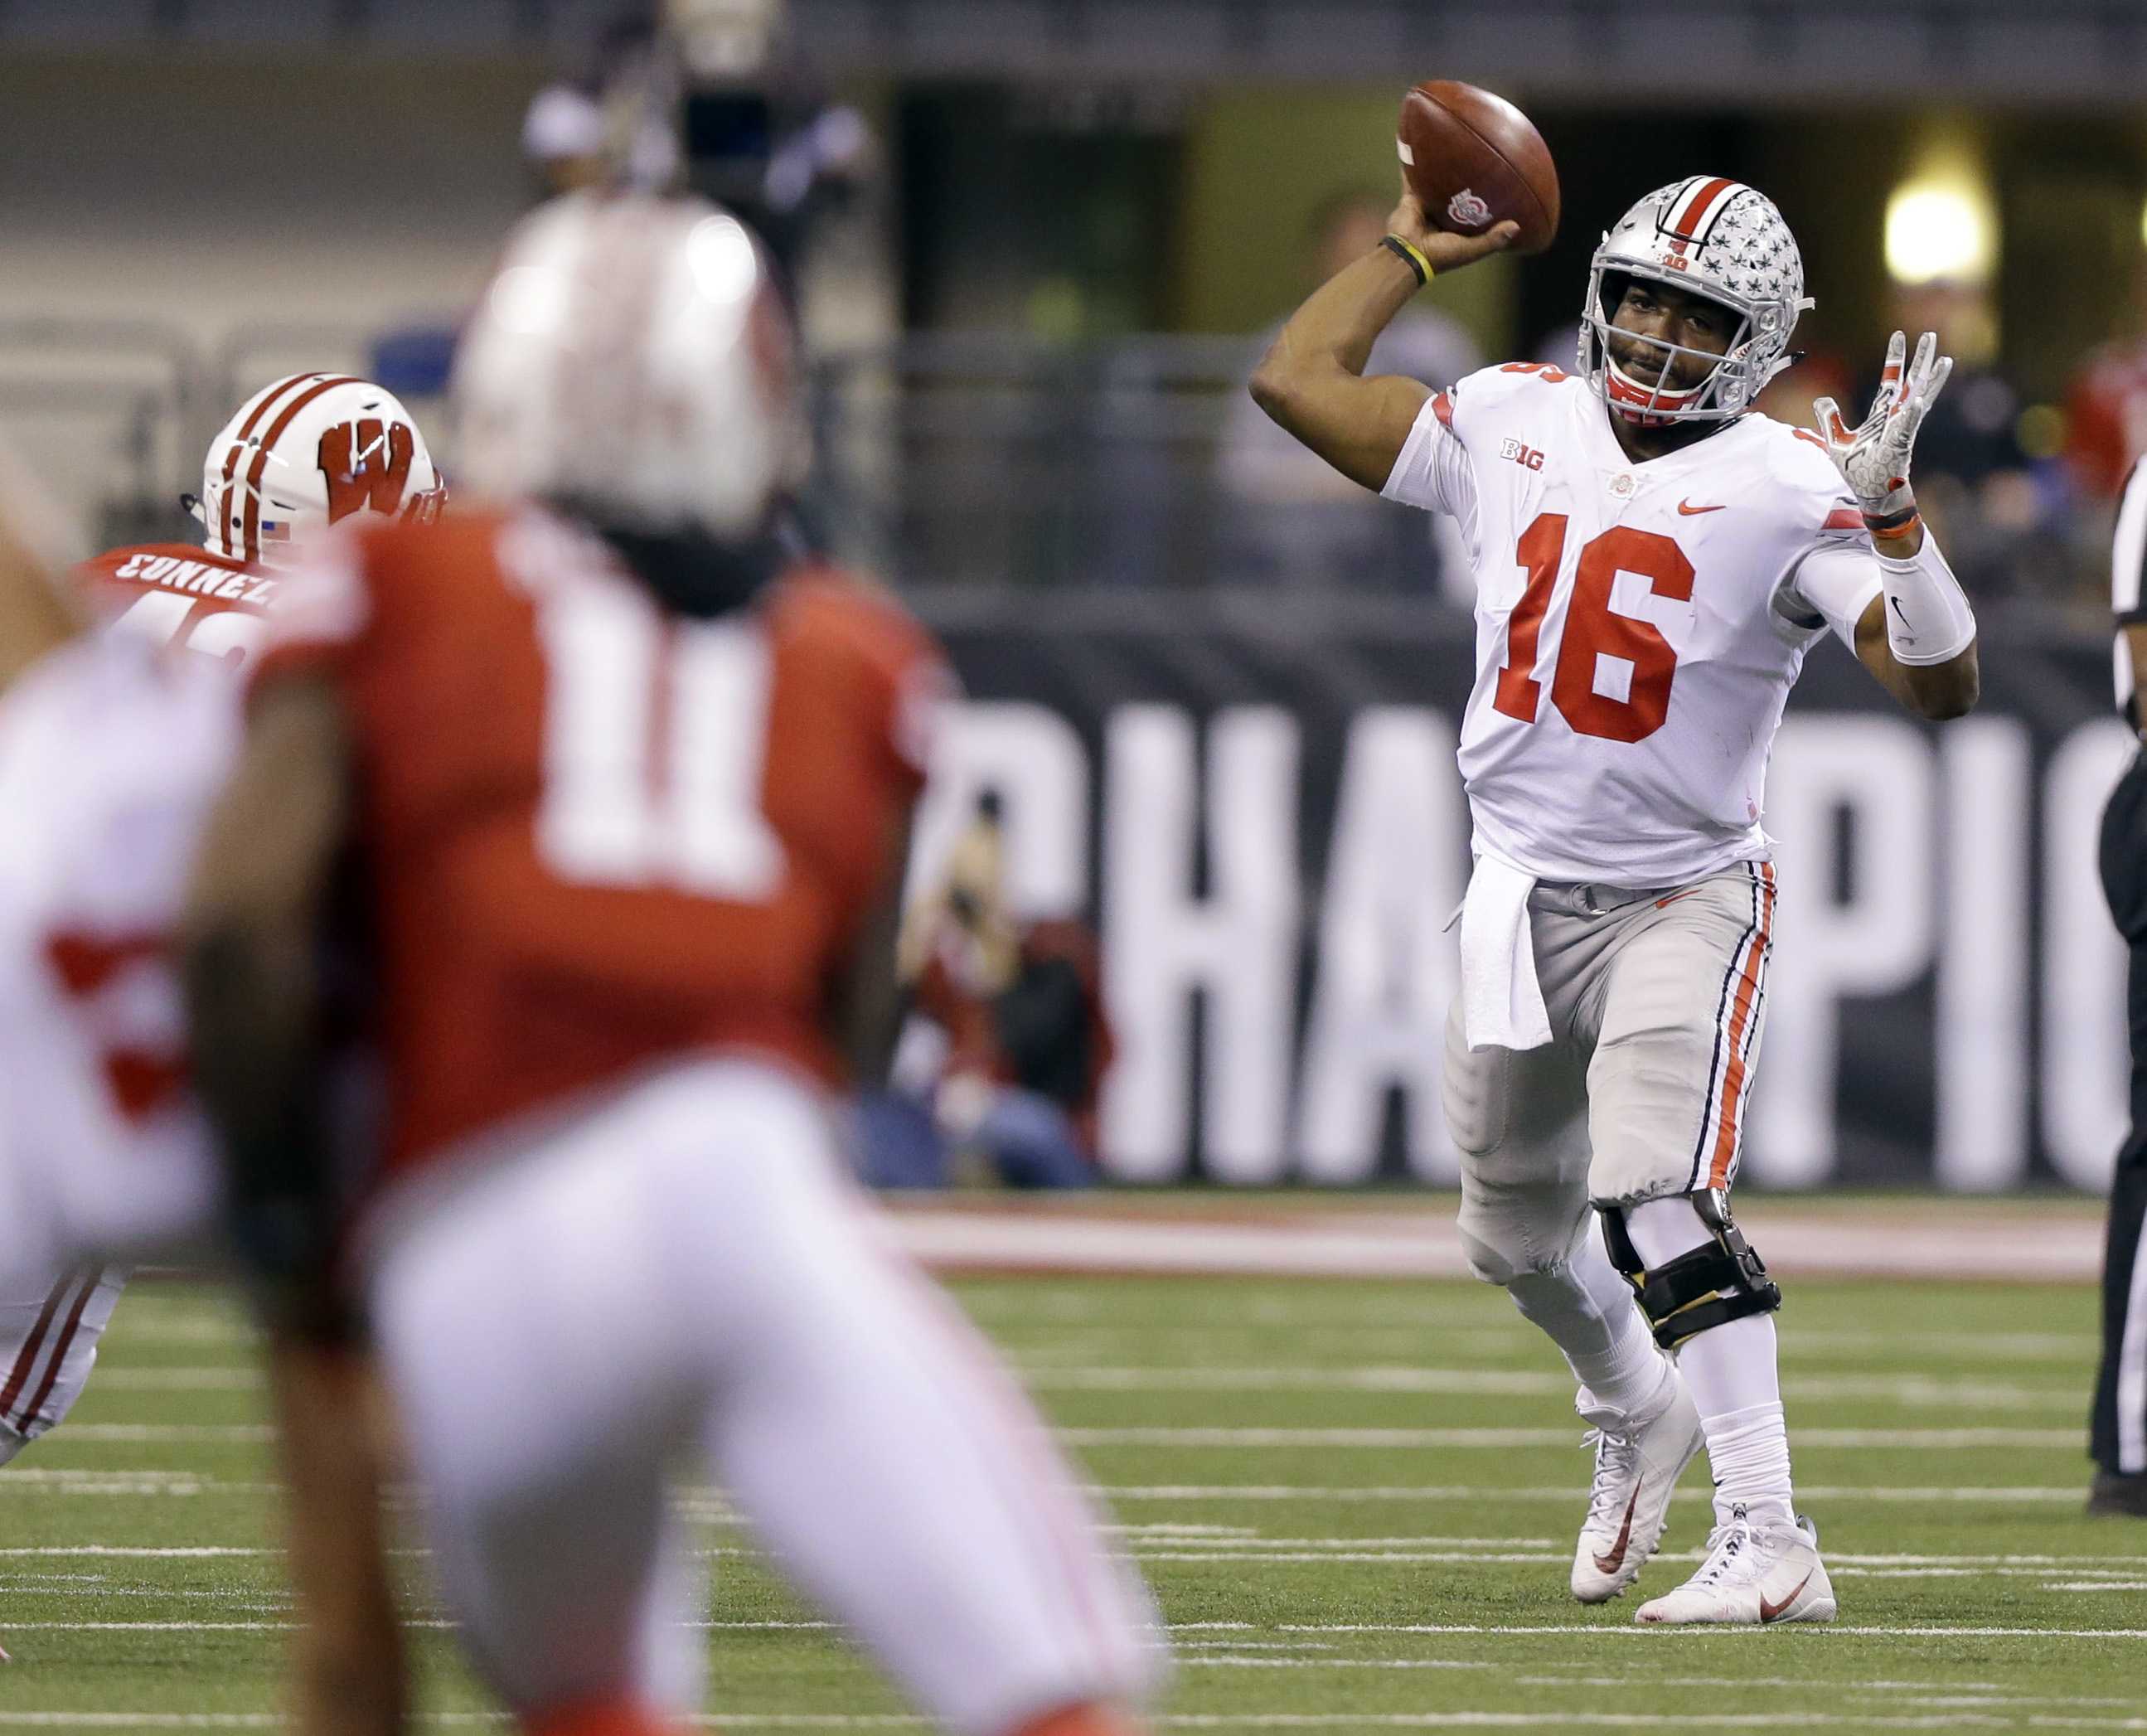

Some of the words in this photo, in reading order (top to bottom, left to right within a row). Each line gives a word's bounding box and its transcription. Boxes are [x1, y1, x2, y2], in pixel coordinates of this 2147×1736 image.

[115, 553, 282, 608] CONNEL
[317, 419, 414, 526] W
[533, 568, 792, 904] 11
[1492, 512, 1697, 744] 16
[895, 699, 2133, 1194] HAPI
